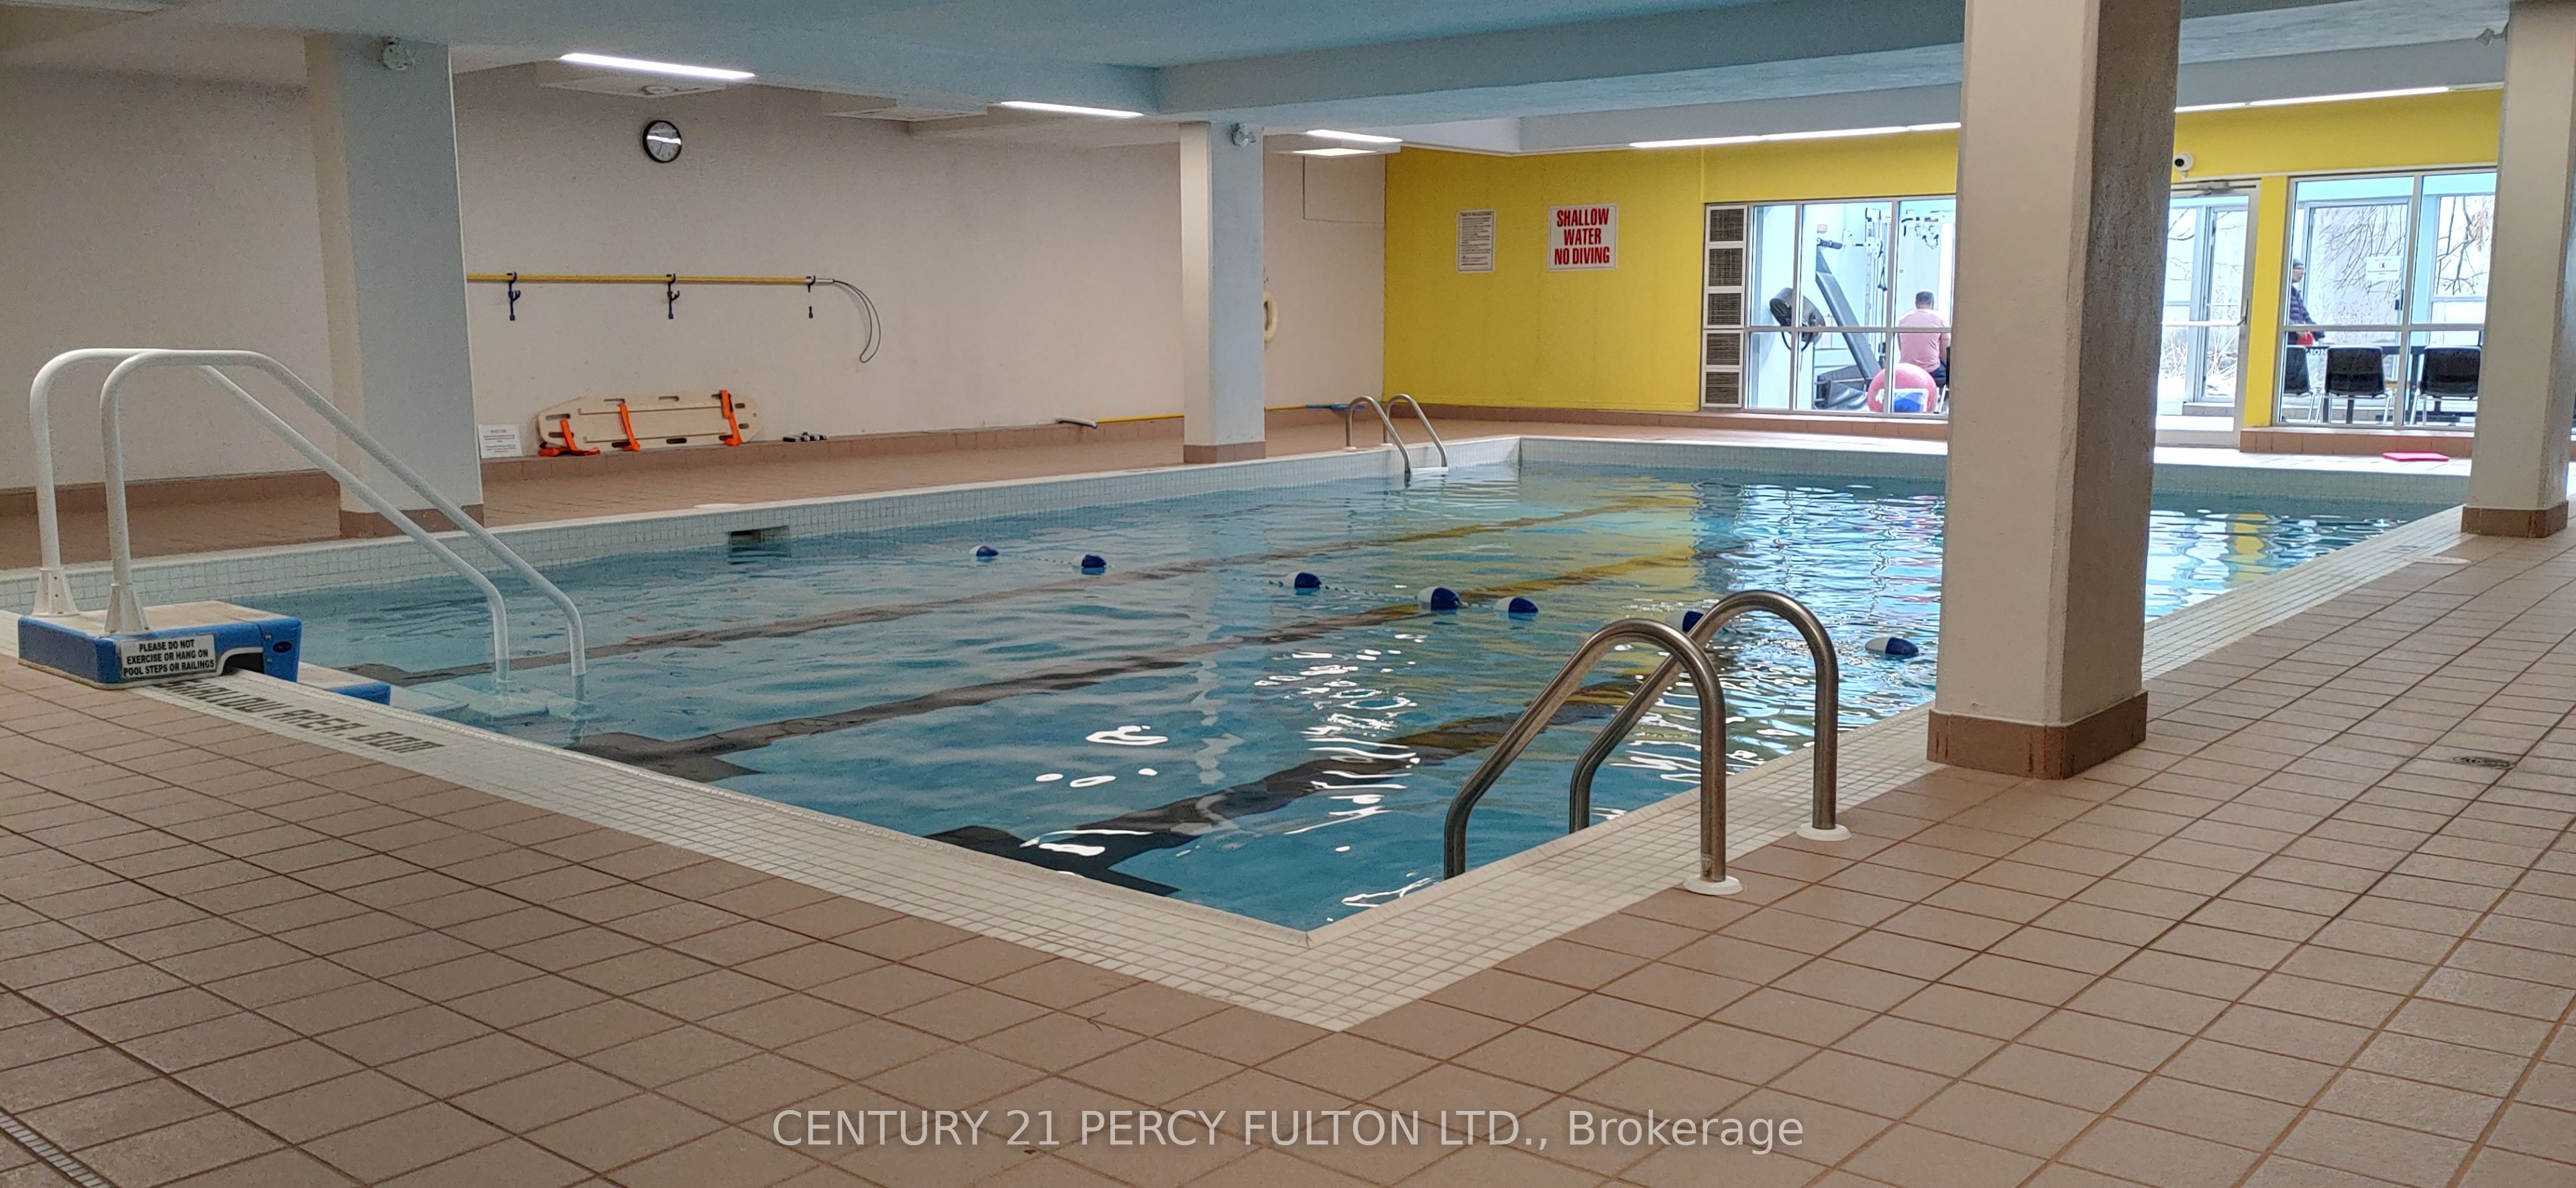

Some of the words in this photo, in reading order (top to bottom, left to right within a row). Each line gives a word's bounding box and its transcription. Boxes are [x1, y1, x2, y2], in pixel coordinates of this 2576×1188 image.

[1556, 208, 1609, 227] SHALLOW
[1564, 228, 1601, 246] WATER
[1554, 248, 1570, 265] NO
[1572, 246, 1609, 264] DIVING
[139, 642, 167, 652] PLEASE
[168, 641, 178, 649] DO
[180, 639, 195, 649] NOT
[127, 653, 162, 665] EXERCISE
[164, 652, 174, 661] OR
[176, 650, 197, 660] HANG
[198, 649, 209, 657] ON
[123, 666, 144, 676] POOL
[145, 664, 168, 674] STEPS
[169, 663, 180, 671] OR
[181, 659, 215, 671] RAILINGS
